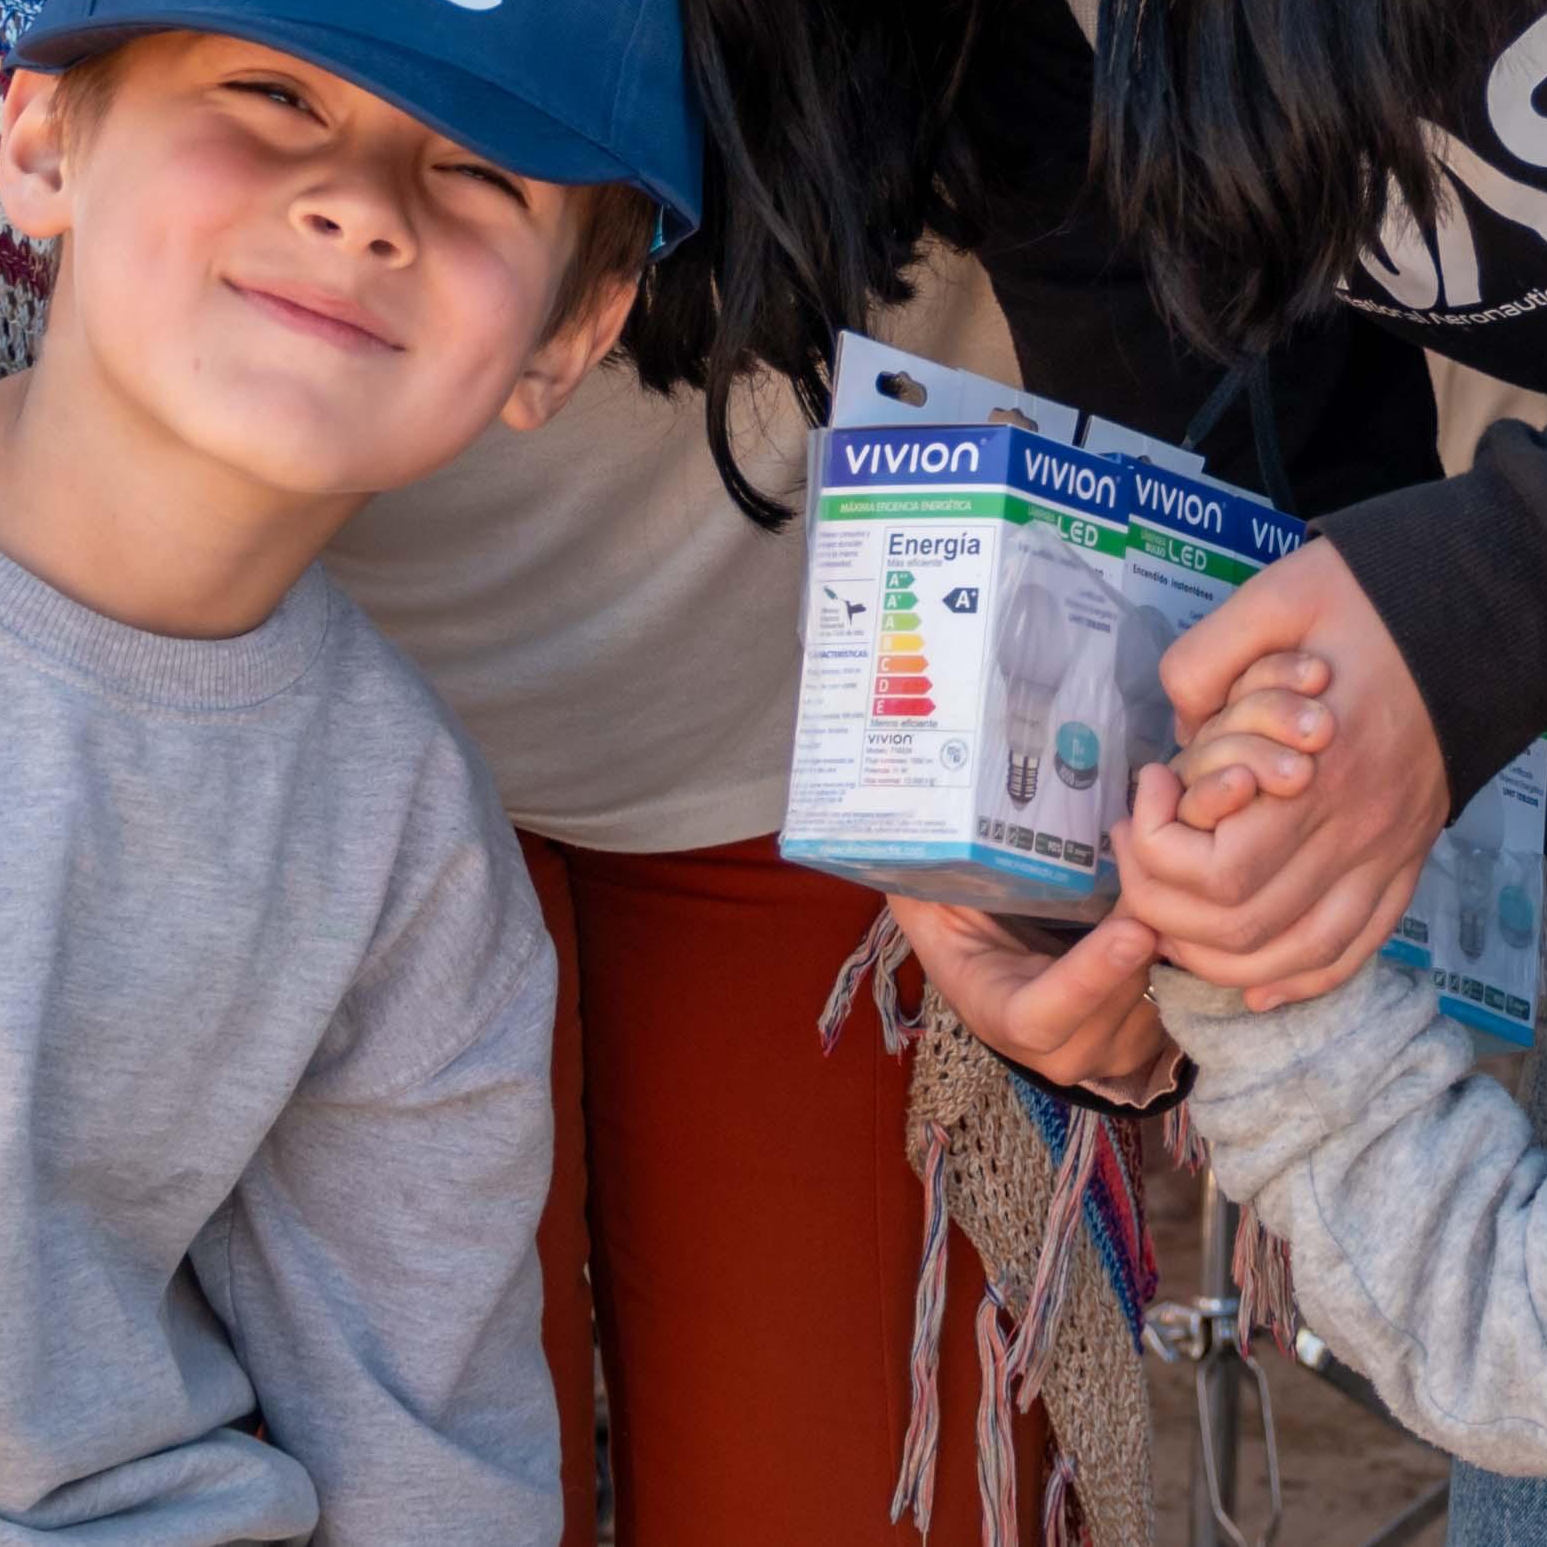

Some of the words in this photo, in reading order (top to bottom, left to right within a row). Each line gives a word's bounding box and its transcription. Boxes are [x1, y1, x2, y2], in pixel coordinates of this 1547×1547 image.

[1056, 515, 1099, 547] LED
[888, 531, 981, 561] Energía
[1168, 539, 1207, 571] LED
[955, 590, 977, 609] A+
[885, 616, 895, 630] A
[881, 657, 891, 671] C
[878, 679, 889, 693] D
[876, 700, 885, 714] E
